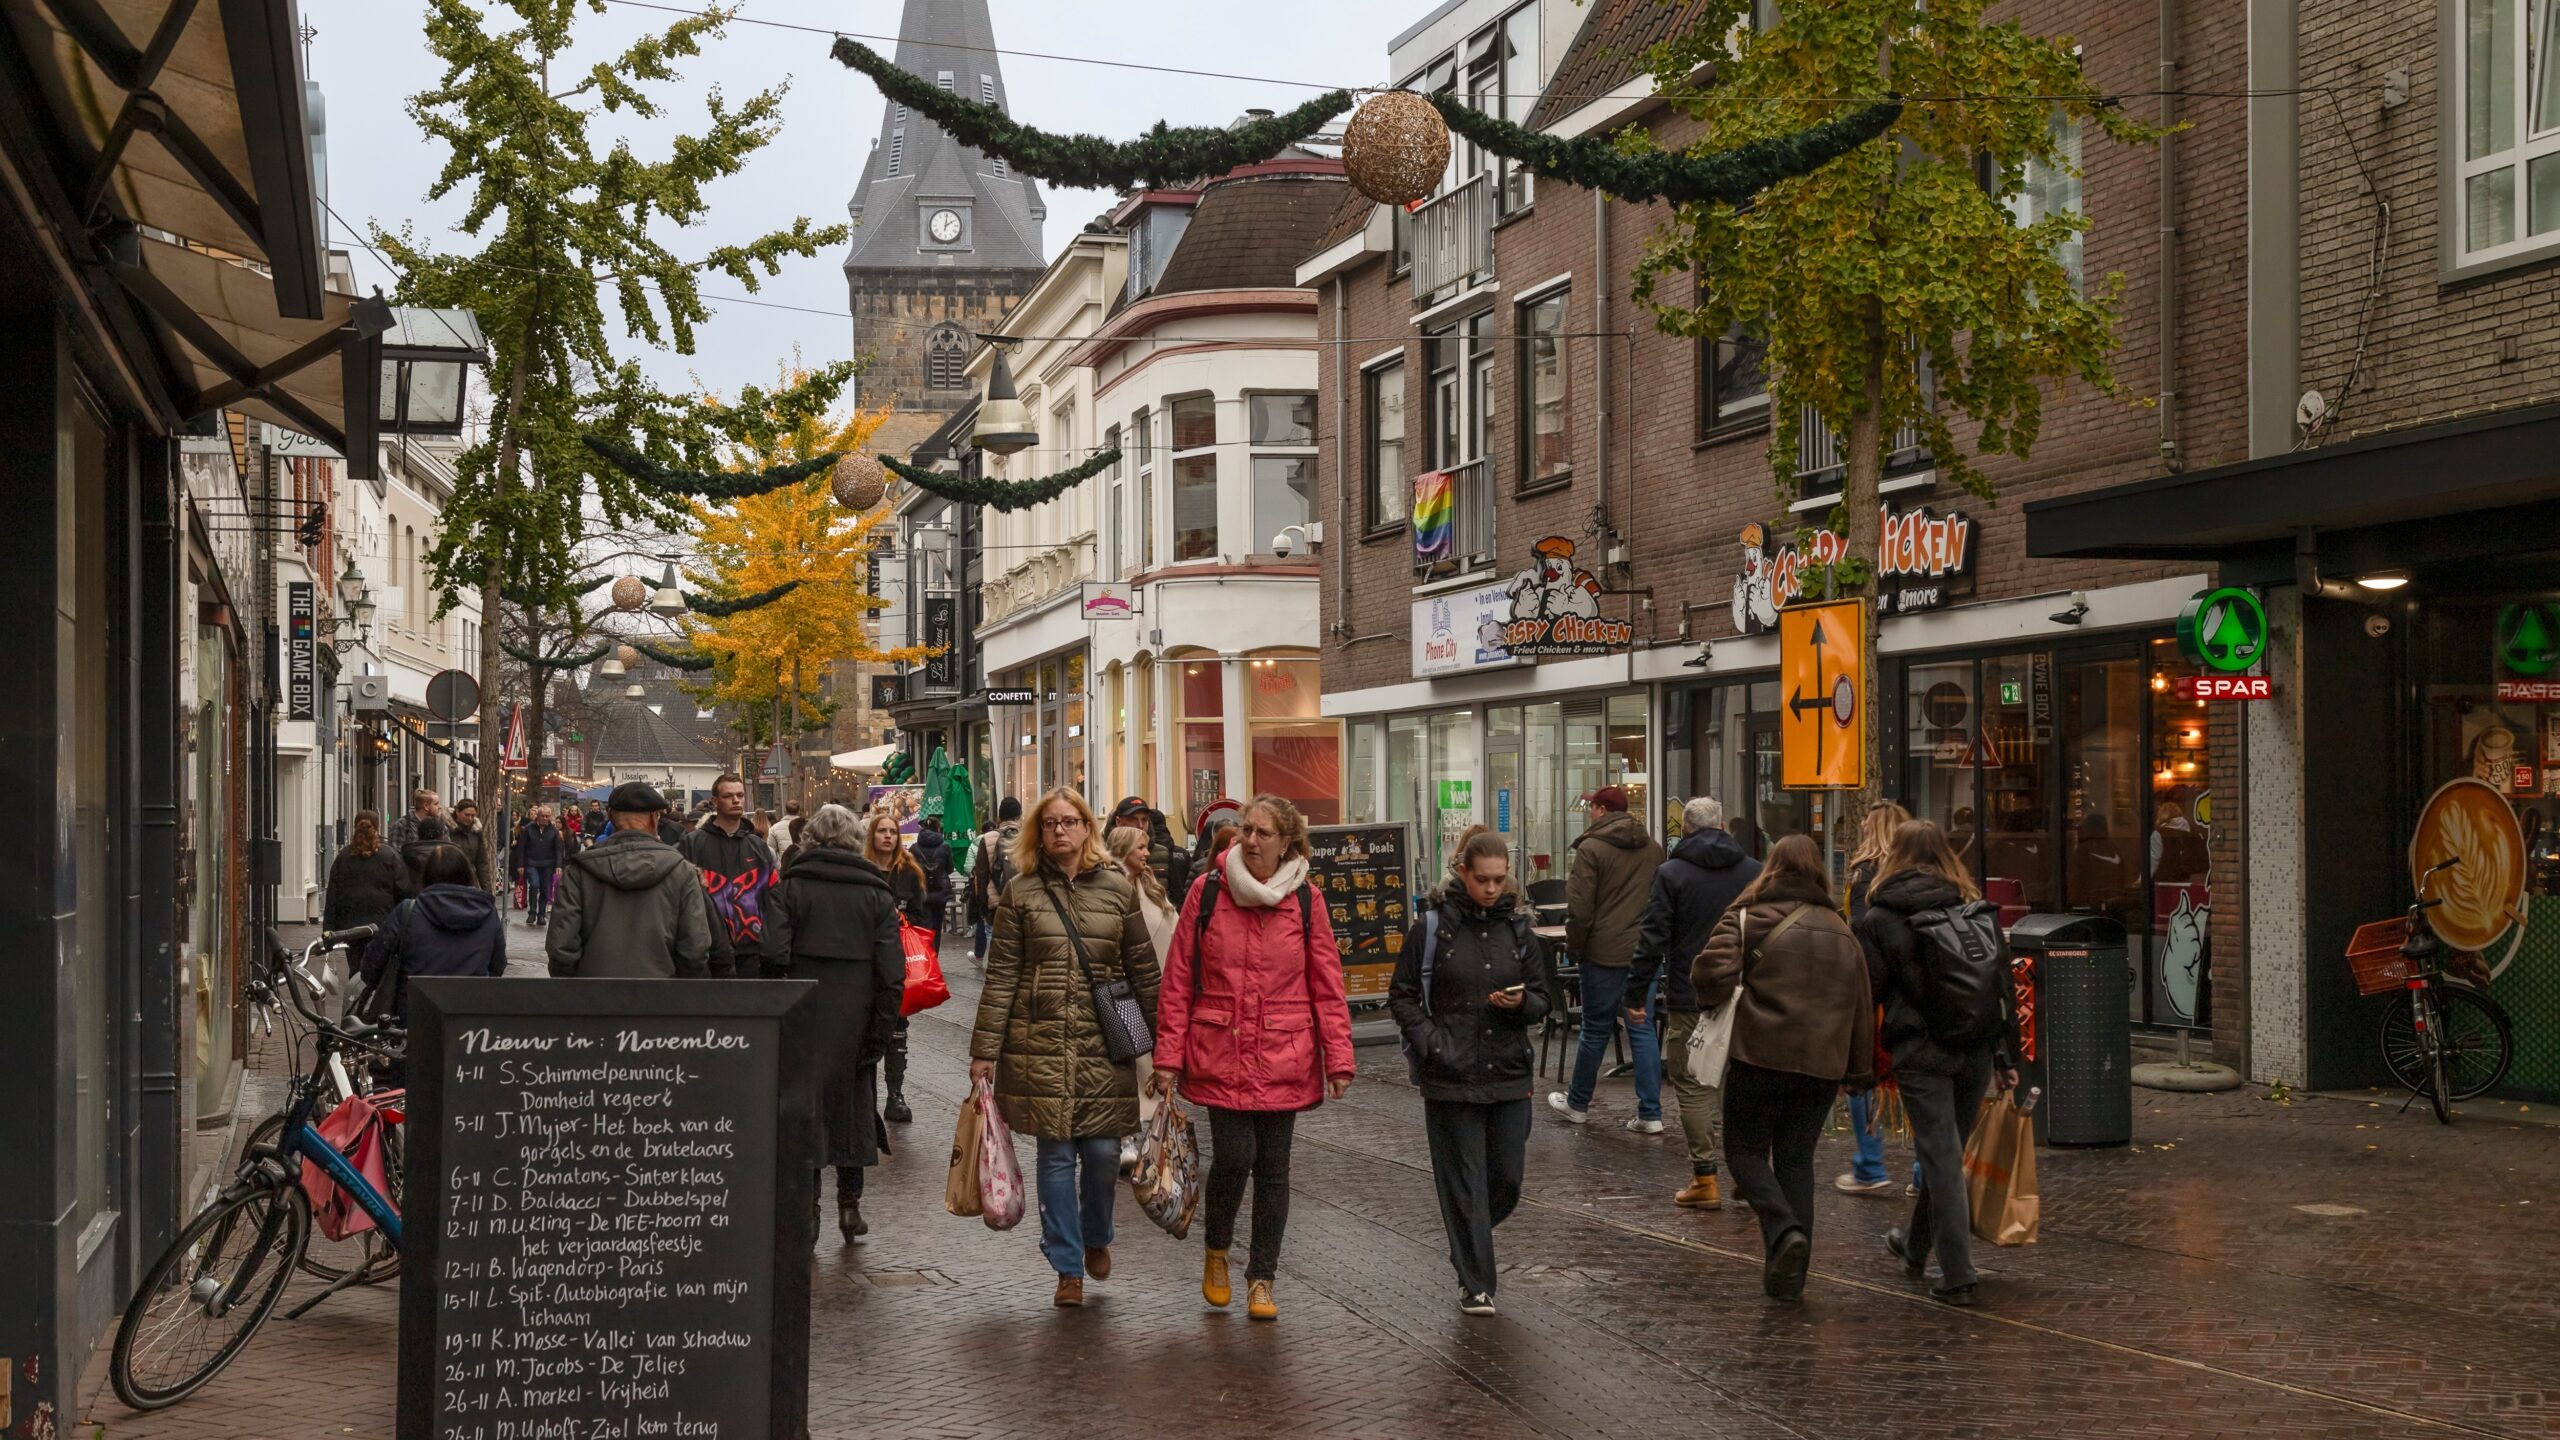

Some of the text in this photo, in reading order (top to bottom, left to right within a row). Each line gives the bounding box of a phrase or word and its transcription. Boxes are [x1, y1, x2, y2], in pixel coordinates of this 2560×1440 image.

[292, 588, 311, 715] THE GAME BOX
[1426, 642, 1444, 660] Phone
[1446, 638, 1458, 661] City
[1513, 646, 1537, 655] Fried
[1538, 645, 1572, 654] Chicken
[1573, 645, 1582, 653] &
[988, 692, 1032, 701] CONFETTI
[2196, 680, 2268, 696] SPAR
[1369, 842, 1395, 854] Deals
[458, 1027, 560, 1055] Nieuw
[615, 1028, 751, 1053] November
[519, 1087, 673, 1116] Domheid regeert
[632, 1116, 675, 1136] boek
[679, 1119, 709, 1133] van
[713, 1115, 735, 1134] de
[589, 1144, 611, 1158] en
[614, 1141, 634, 1160] de
[643, 1137, 735, 1159] brutelaars
[623, 1188, 729, 1213] Dubbelspel
[709, 1213, 729, 1228] en
[521, 1230, 704, 1263] het verjaardagsfeestje
[618, 1255, 664, 1279] Paris
[676, 1282, 706, 1298] van
[645, 1332, 676, 1349] van
[599, 1354, 625, 1375] De
[590, 1417, 629, 1440] Ziel
[672, 1410, 718, 1440] terug
